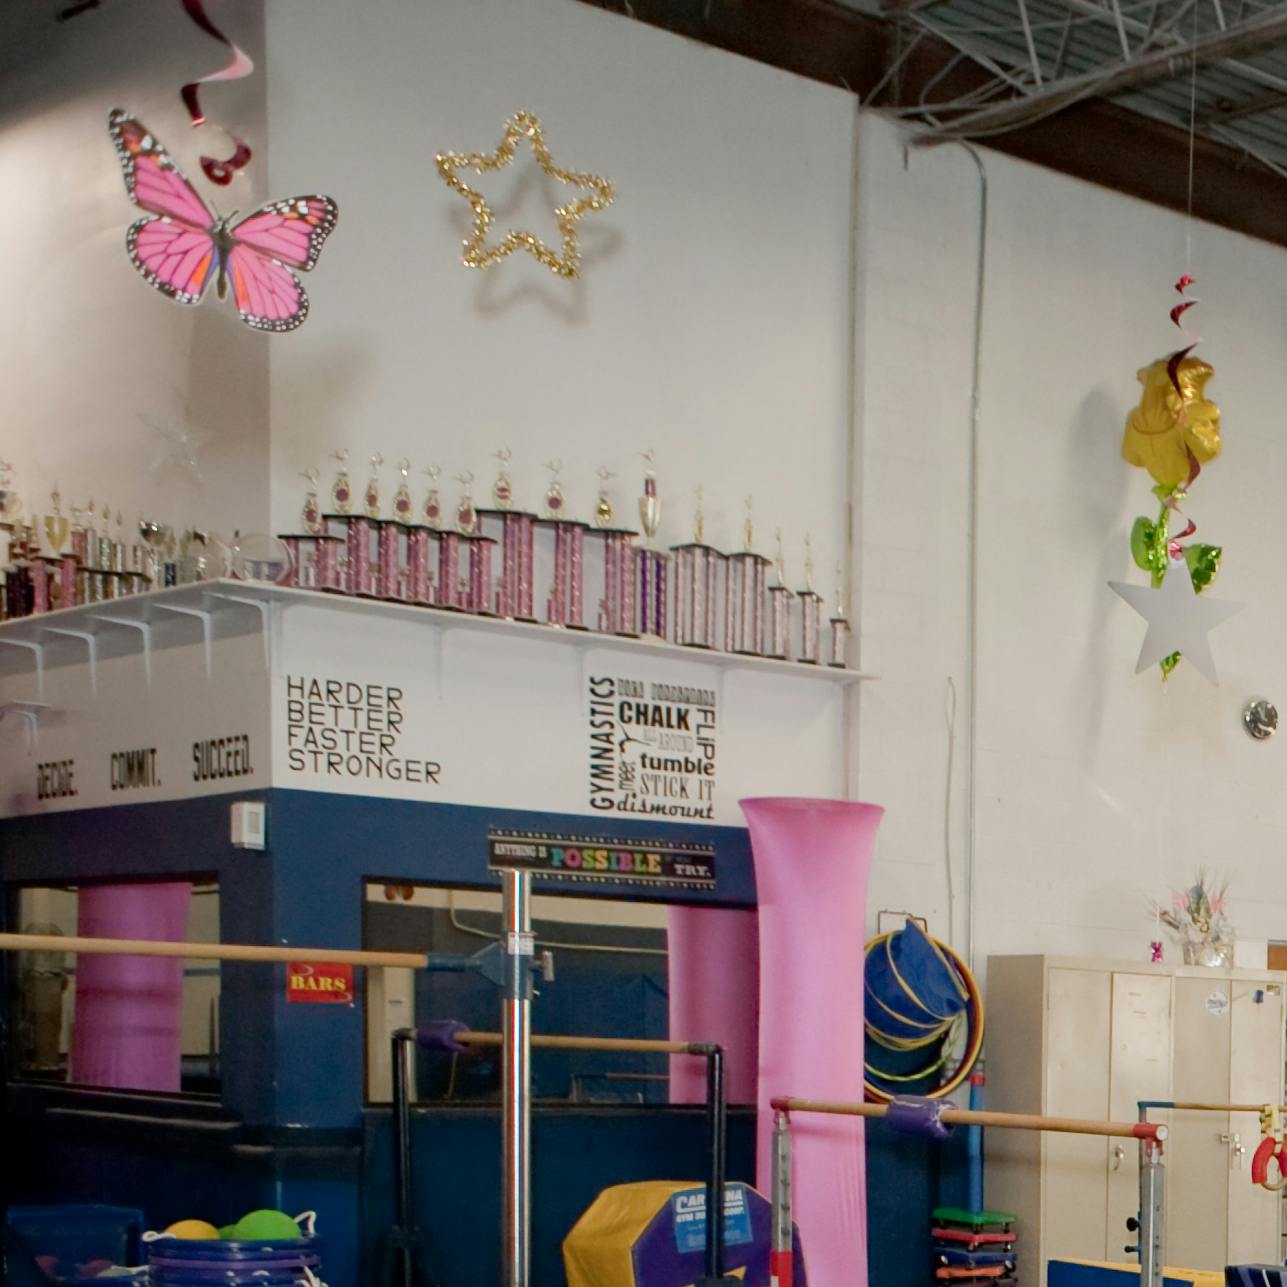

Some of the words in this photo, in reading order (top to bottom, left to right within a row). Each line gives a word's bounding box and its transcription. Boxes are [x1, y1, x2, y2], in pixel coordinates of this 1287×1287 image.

[286, 674, 404, 710] HARDER
[286, 699, 404, 735] BETTER
[618, 700, 691, 731] CHALK
[286, 724, 396, 757] FASTER
[589, 675, 615, 810] GYMNASTICS
[110, 747, 161, 790] COMMIT.
[193, 734, 254, 782] SUCCEED.
[288, 748, 442, 784] STRONGER
[640, 752, 715, 776] tumble
[640, 773, 689, 799] STICK
[699, 779, 715, 801] IT
[617, 792, 715, 820] dismount
[551, 848, 663, 874] POSSIBLE
[673, 863, 712, 878] TRY.
[290, 974, 347, 991] BARS
